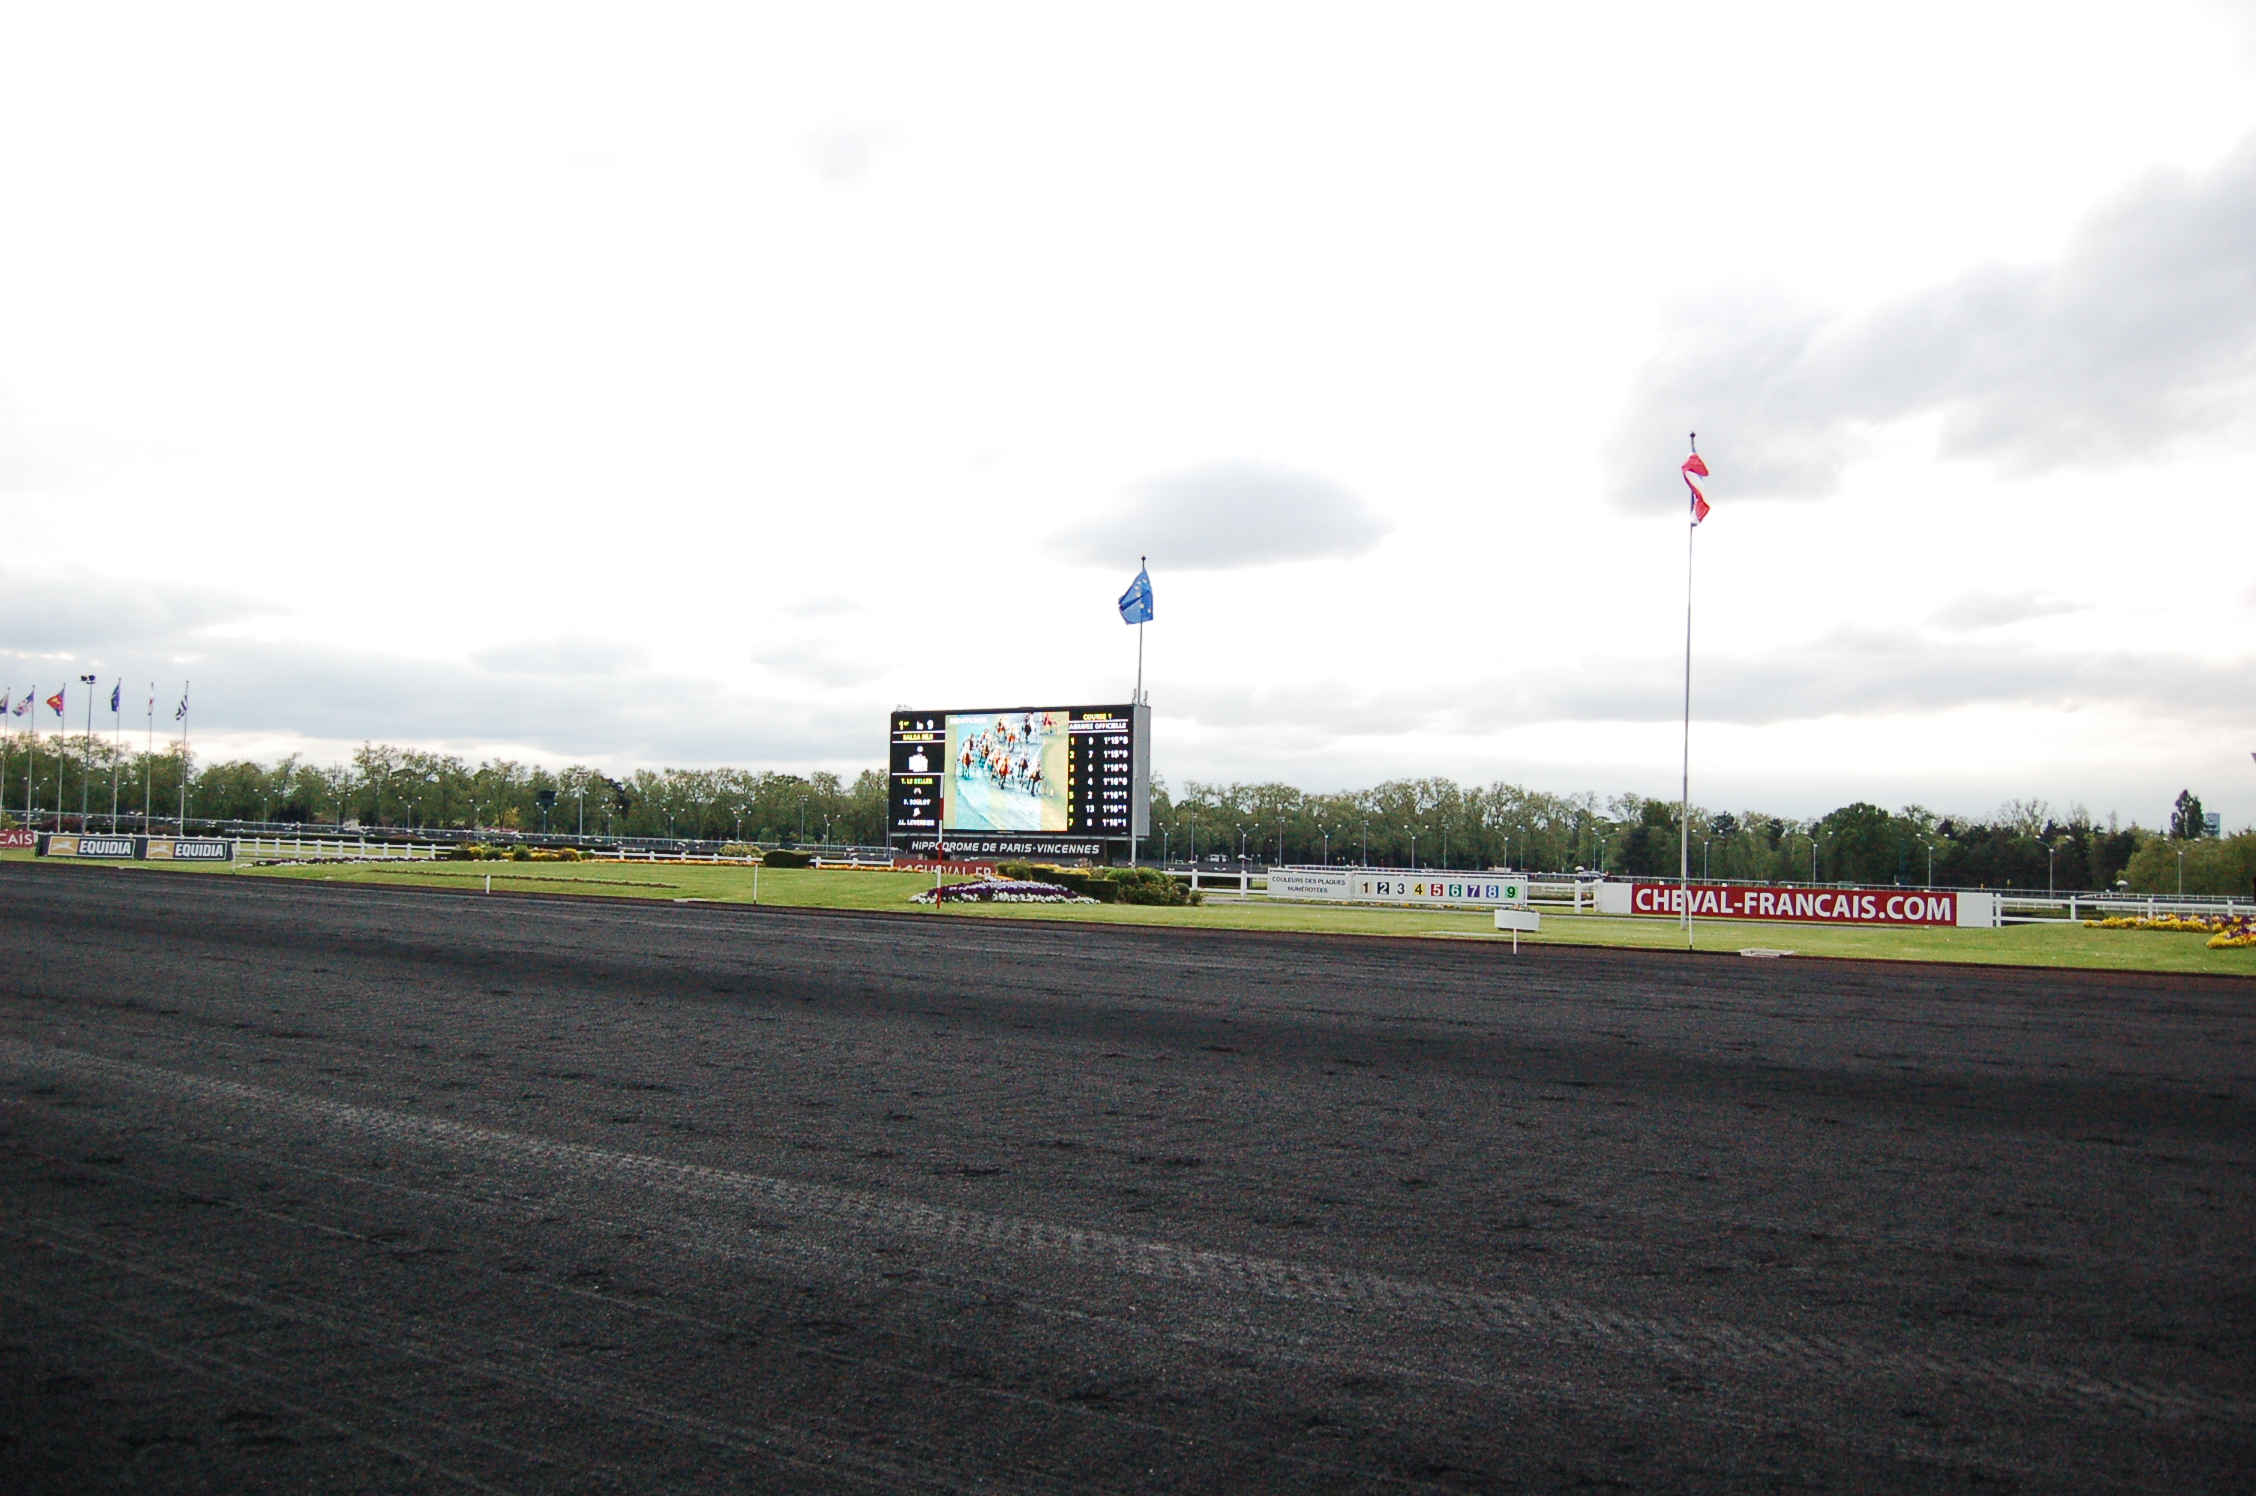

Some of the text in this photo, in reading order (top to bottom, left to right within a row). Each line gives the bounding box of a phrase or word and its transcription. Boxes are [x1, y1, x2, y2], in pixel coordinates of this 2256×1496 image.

[927, 720, 934, 730] 9
[1070, 764, 1074, 772] 3
[79, 840, 131, 855] EQUIDIA
[175, 844, 224, 857] EQUIDIA
[911, 841, 979, 851] HIPPODROME
[981, 842, 996, 852] DE
[1363, 883, 1516, 898] 1 2 3 4 5 6 7 8 9
[1636, 888, 1951, 920] CHEVAL-FRANCAIS.COM
